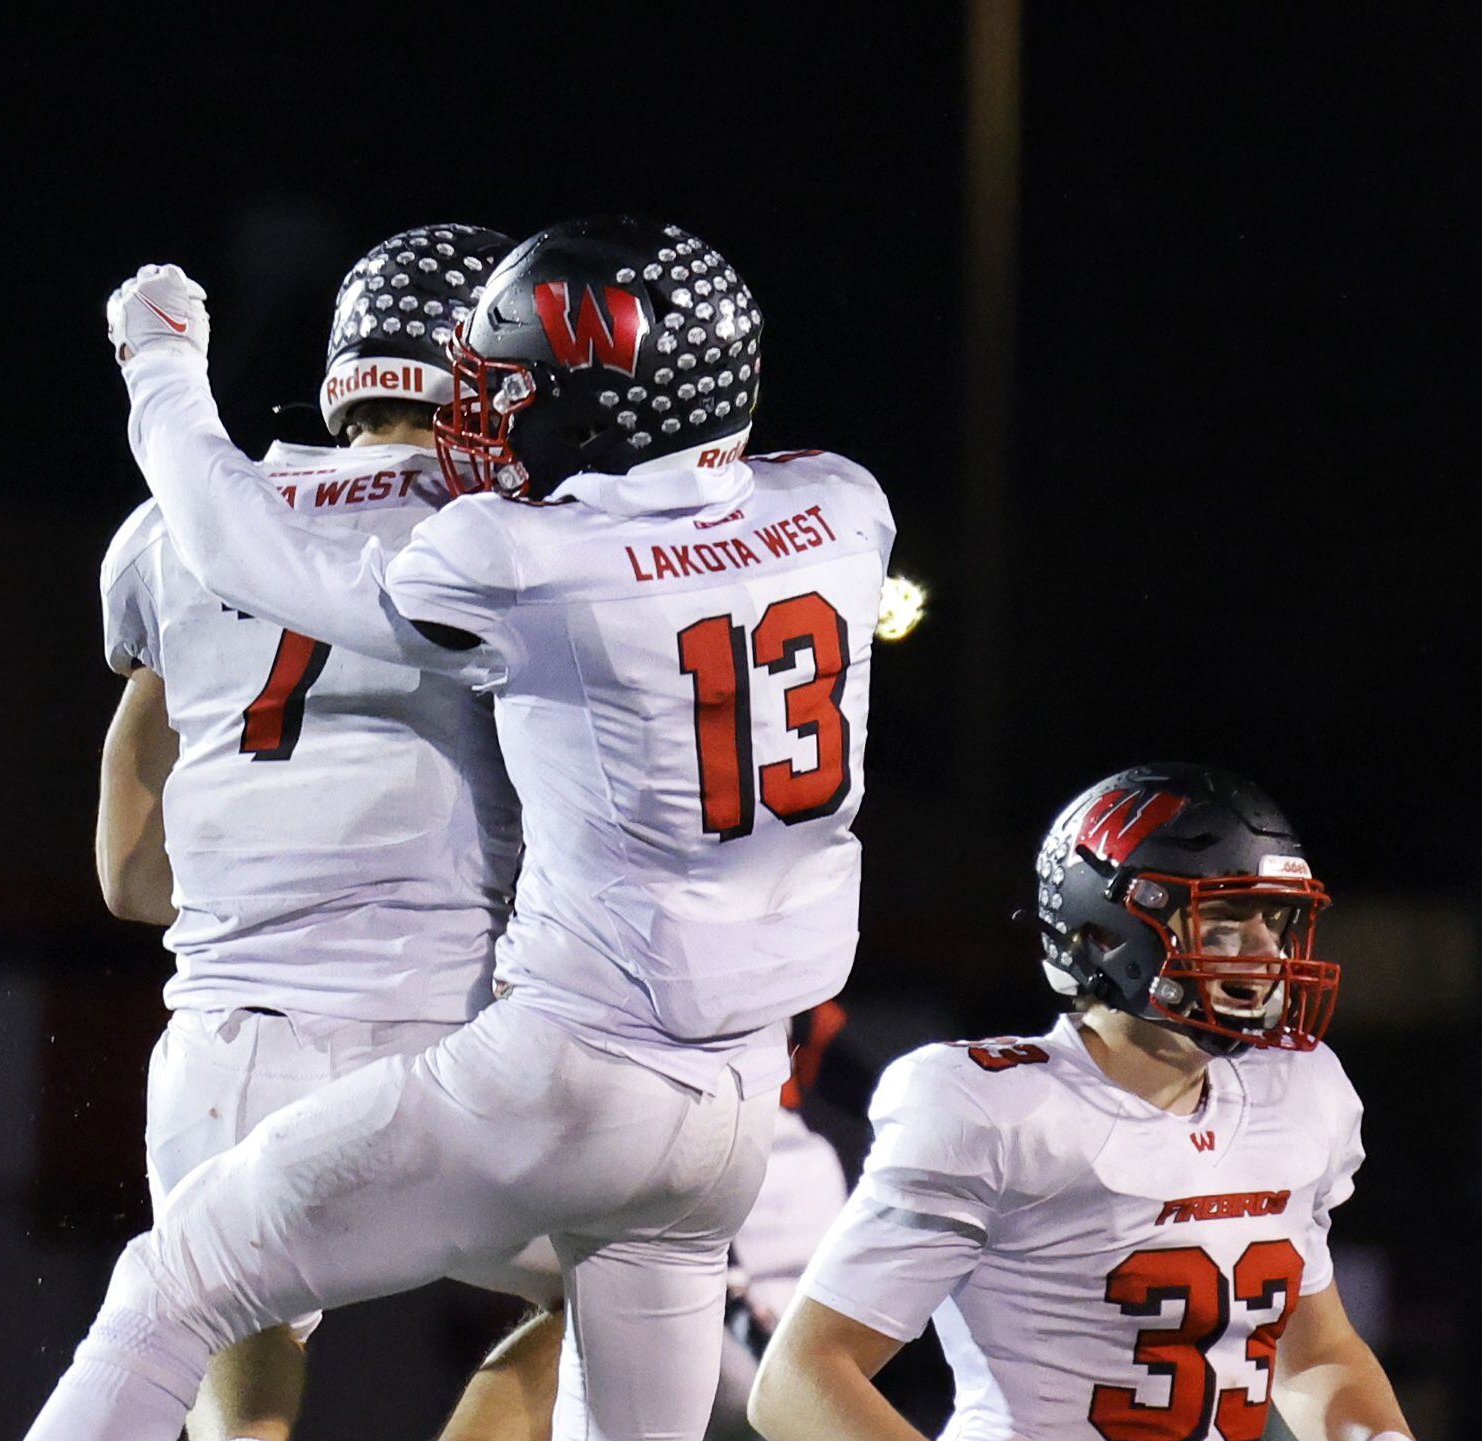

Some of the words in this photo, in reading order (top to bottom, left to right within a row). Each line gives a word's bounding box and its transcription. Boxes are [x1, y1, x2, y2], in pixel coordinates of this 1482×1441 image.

[325, 365, 424, 405] Riddell
[314, 469, 423, 508] WEST
[625, 537, 762, 582] LAKOTA
[753, 504, 837, 558] WEST
[676, 590, 851, 843] 13
[1189, 1130, 1215, 1153] W
[1154, 1189, 1292, 1227] FIREBIRDS
